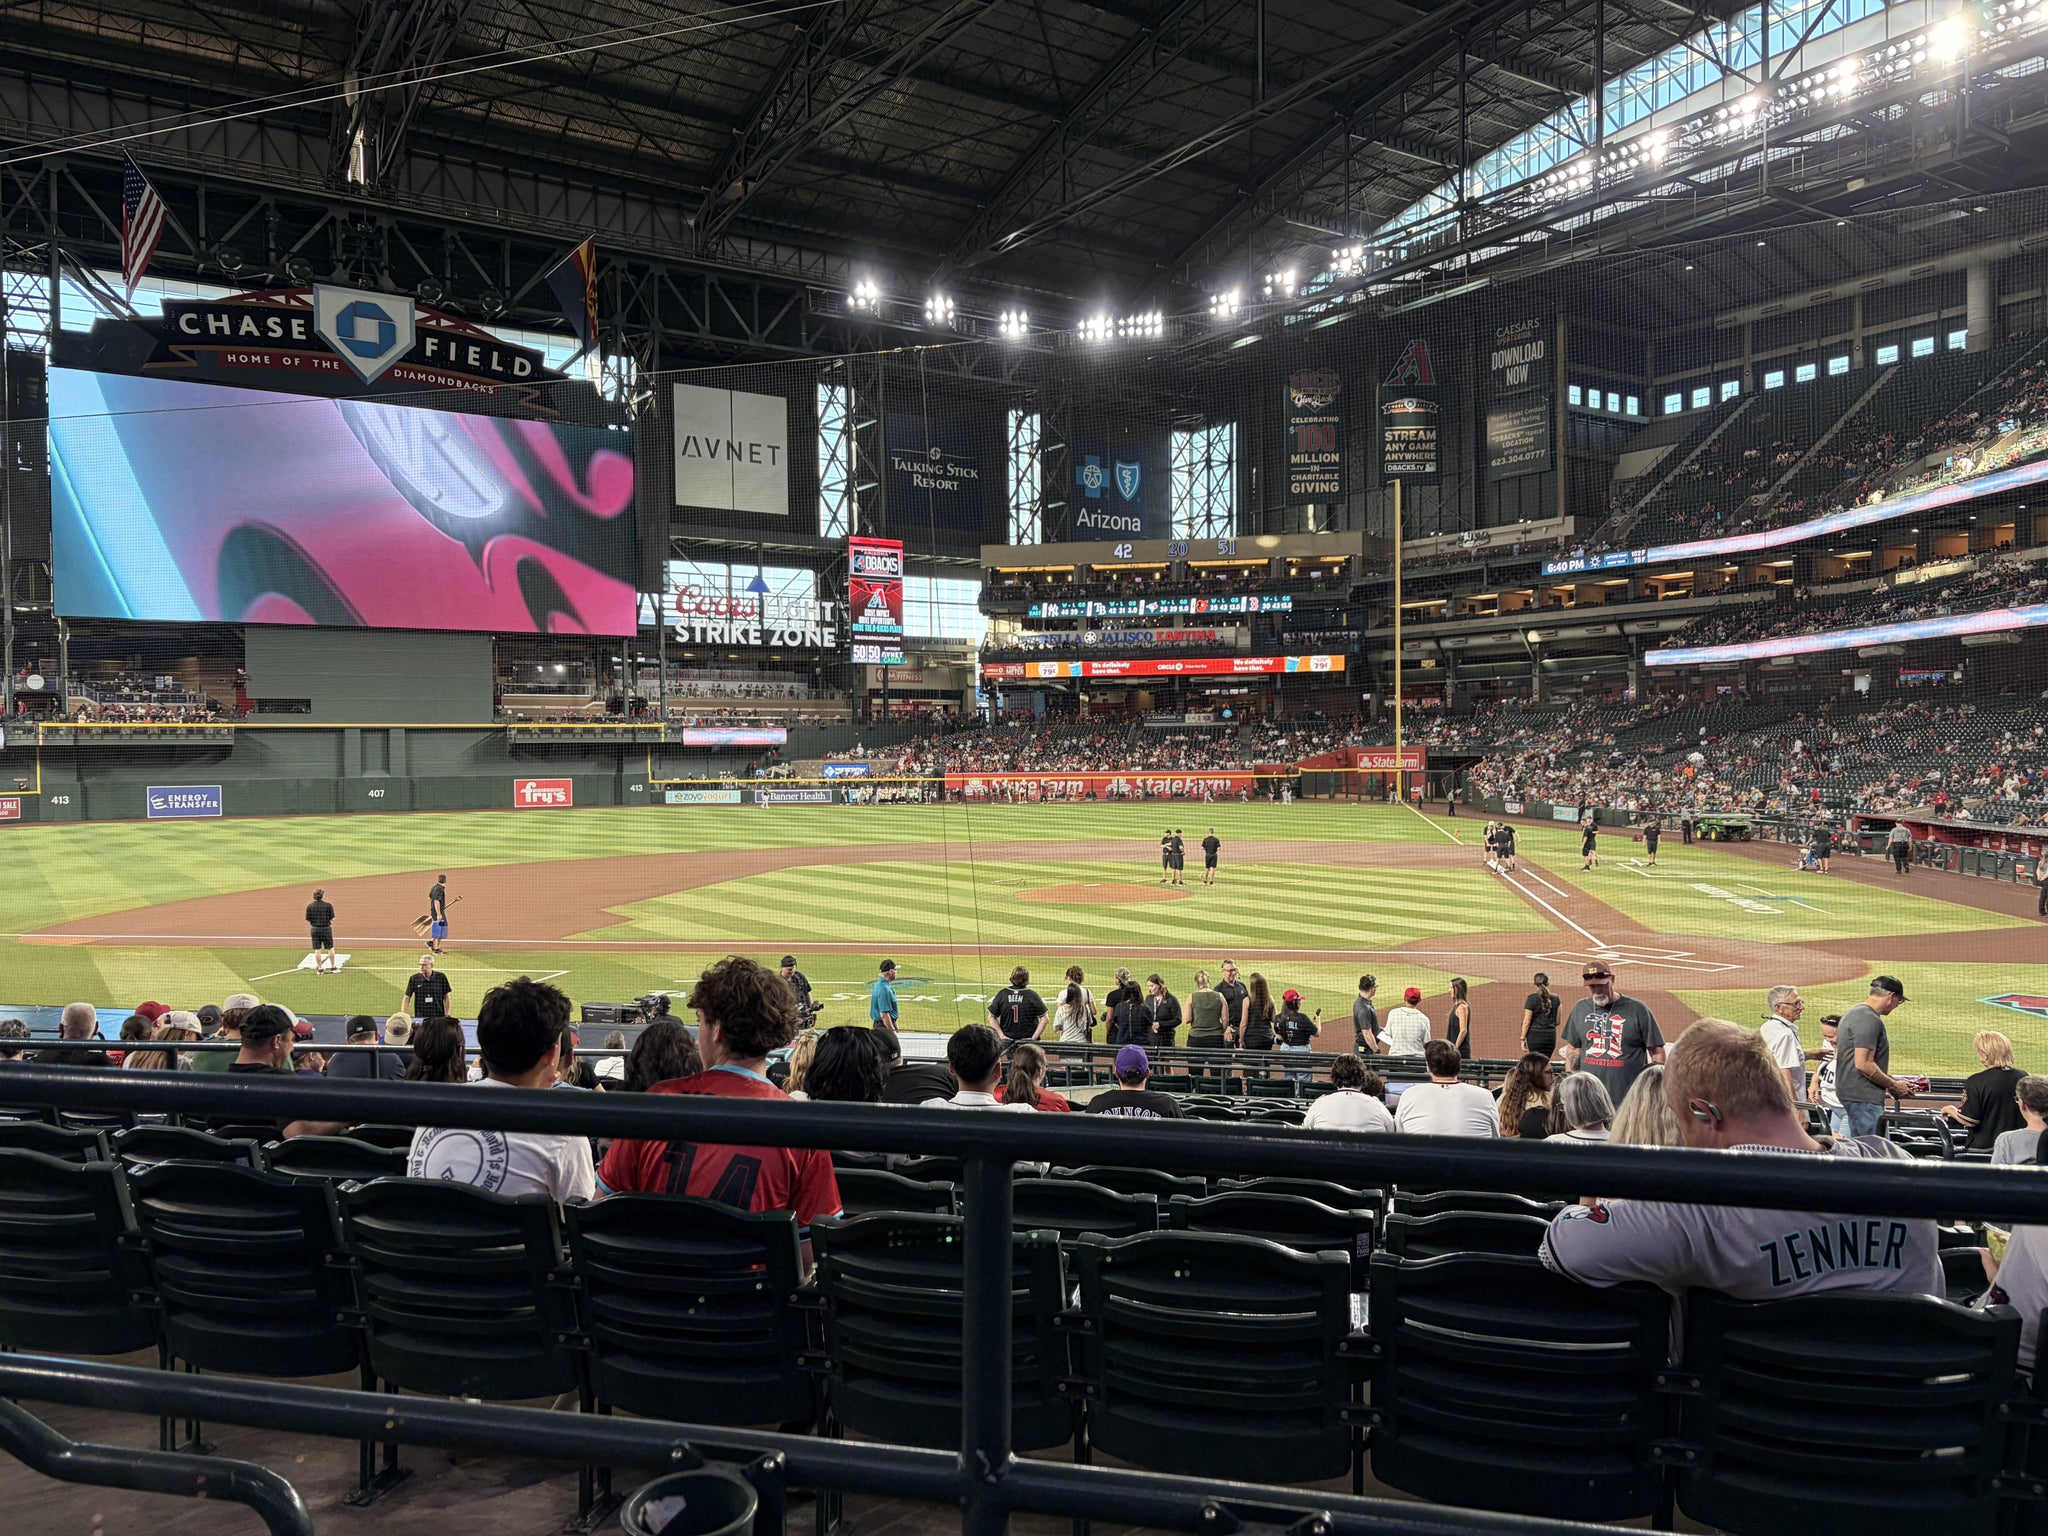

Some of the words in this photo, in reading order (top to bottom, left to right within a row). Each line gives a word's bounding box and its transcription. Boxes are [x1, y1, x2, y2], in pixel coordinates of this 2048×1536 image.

[1496, 318, 1540, 338] CAESARS
[179, 313, 307, 340] CHASE
[425, 337, 532, 377] FIELD
[1492, 341, 1544, 371] DOWNLOAD
[227, 354, 271, 364] HOME
[282, 357, 300, 366] OF
[312, 359, 340, 370] THE
[394, 369, 494, 394] DIAMONDBACKS
[1507, 364, 1528, 387] NOW
[1385, 430, 1436, 441] STREAM
[1502, 436, 1534, 448] LOCATION
[681, 435, 781, 466] AVNET
[1385, 443, 1405, 451] ANY
[1409, 442, 1436, 451] GAME
[1291, 453, 1339, 463] MILLION
[1385, 452, 1436, 460] ANYWHERE
[1491, 449, 1546, 467] 623.304.0777
[1291, 473, 1339, 481] CHARITABLE
[1291, 482, 1339, 494] GIVING
[1077, 508, 1141, 532] Arizona
[1114, 543, 1133, 558] 42
[1168, 542, 1188, 556] 20
[1218, 540, 1236, 555] 51
[866, 556, 898, 572] DBACKS
[1547, 562, 1567, 573] 6:40
[1569, 559, 1585, 570] PM
[674, 584, 756, 617] Coors
[764, 600, 834, 621] LIGHT
[675, 622, 762, 645] STRIKE
[770, 627, 836, 648] ZONE
[1099, 630, 1153, 643] JALISCO
[1156, 628, 1216, 642] CANTINA
[896, 673, 922, 681] FITNESS
[368, 789, 384, 798] 407
[520, 781, 567, 804] fry's
[630, 784, 643, 792] 413
[771, 787, 800, 800] Banner
[801, 786, 827, 800] Health
[3, 801, 17, 809] SALE
[51, 796, 70, 805] 413
[168, 794, 208, 802] ENERGY
[168, 801, 218, 809] TRANSFER
[664, 1142, 762, 1209] 14
[1760, 1219, 1907, 1288] ZENNER
